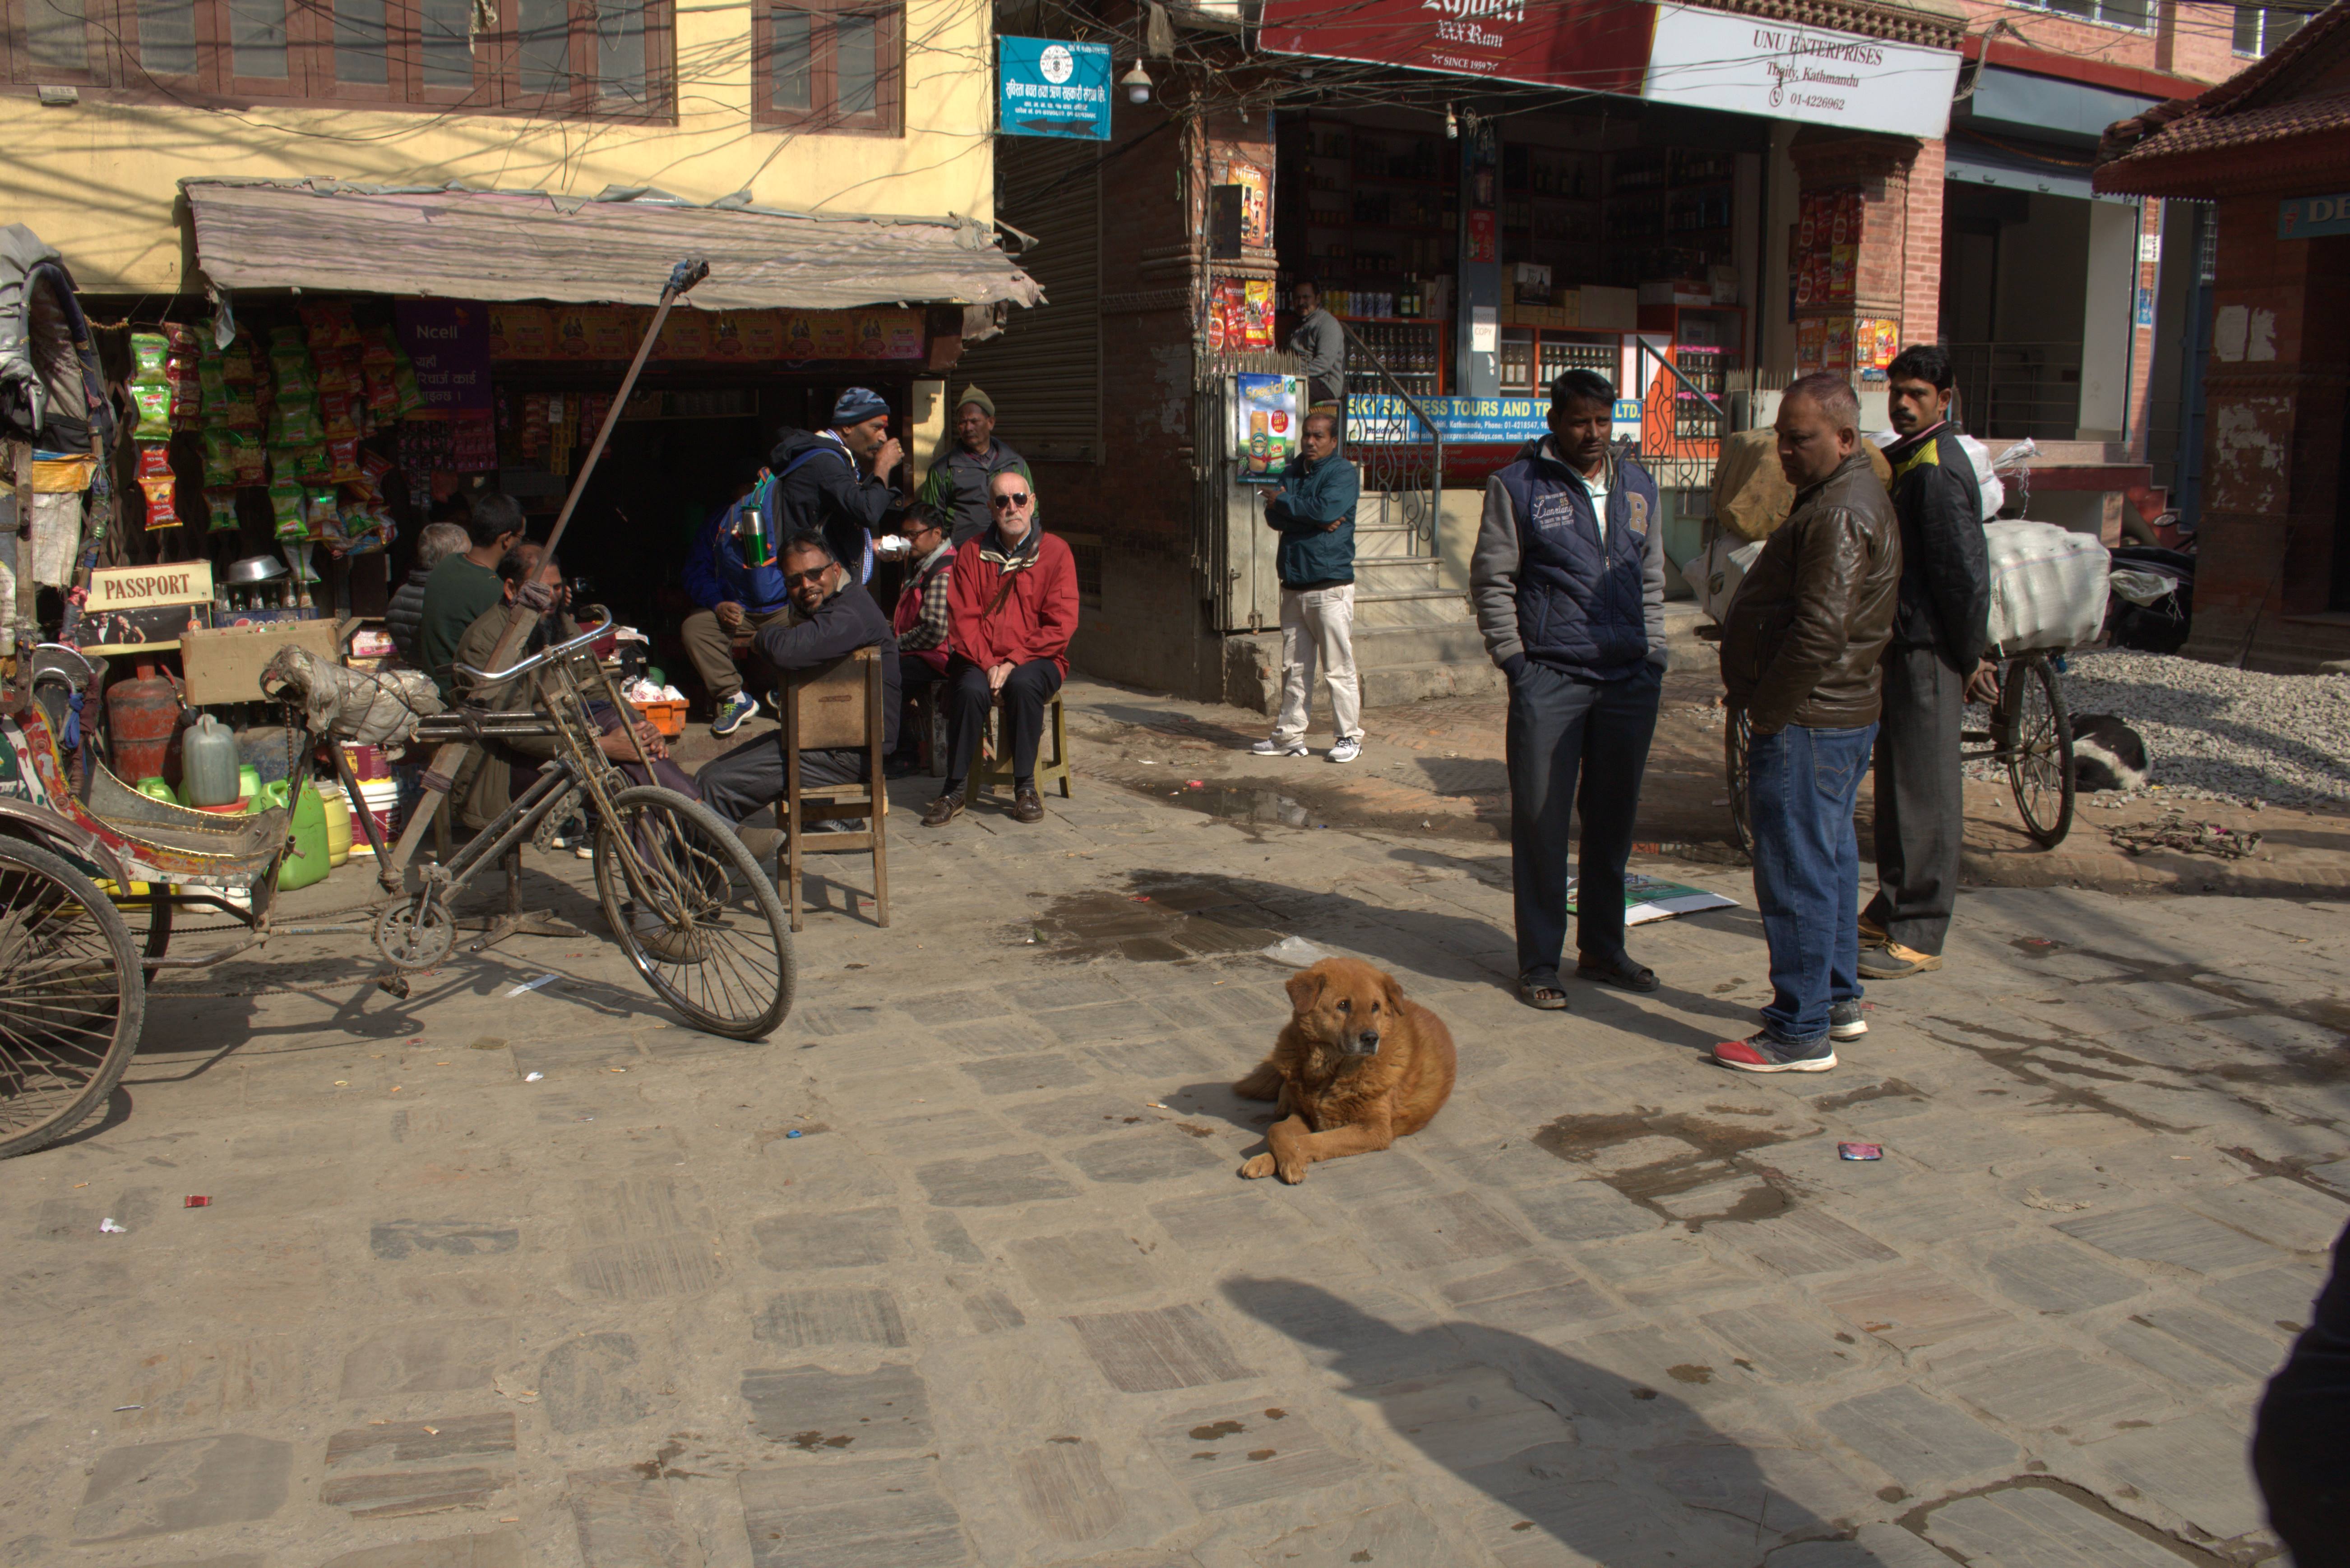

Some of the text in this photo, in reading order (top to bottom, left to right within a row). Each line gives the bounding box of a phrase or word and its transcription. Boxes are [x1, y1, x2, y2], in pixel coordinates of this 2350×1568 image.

[1465, 23, 1503, 48] Rum
[1753, 30, 1883, 66] UNU ENTERPRISES
[1443, 56, 1486, 69] SINCE 1959
[1804, 67, 1859, 88] Kathmandu
[1025, 83, 1037, 97] बचत
[1038, 85, 1048, 98] तथा
[1062, 83, 1082, 101] सहकारी
[1790, 93, 1845, 111] 01-4226962
[1474, 312, 1495, 321] PHOTO
[416, 325, 458, 339] Ncell
[1475, 327, 1492, 336] COPY
[416, 370, 477, 385] रिचार्ज कार्ड
[1245, 378, 1285, 403] Special
[1348, 398, 1379, 415] SKY
[1453, 400, 1499, 417] TOURS
[1502, 401, 1530, 417] AND
[1615, 404, 1641, 418] LTD.
[1449, 421, 1483, 430] Kathmandu,
[104, 573, 190, 600] PASSPORT
